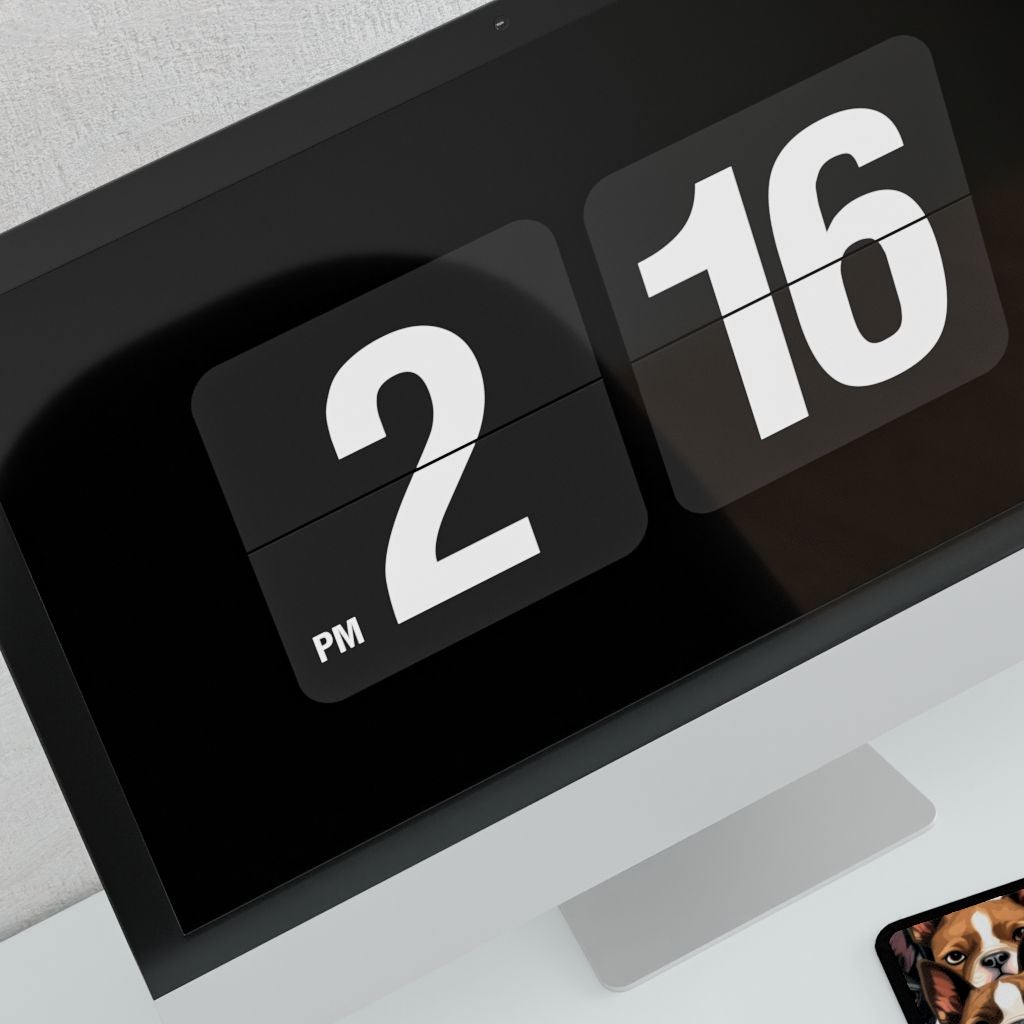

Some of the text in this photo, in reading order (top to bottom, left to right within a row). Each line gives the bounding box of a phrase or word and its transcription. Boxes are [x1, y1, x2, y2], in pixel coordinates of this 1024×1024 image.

[638, 108, 949, 440] 16
[326, 326, 541, 624] 2
[312, 616, 366, 664] PM
